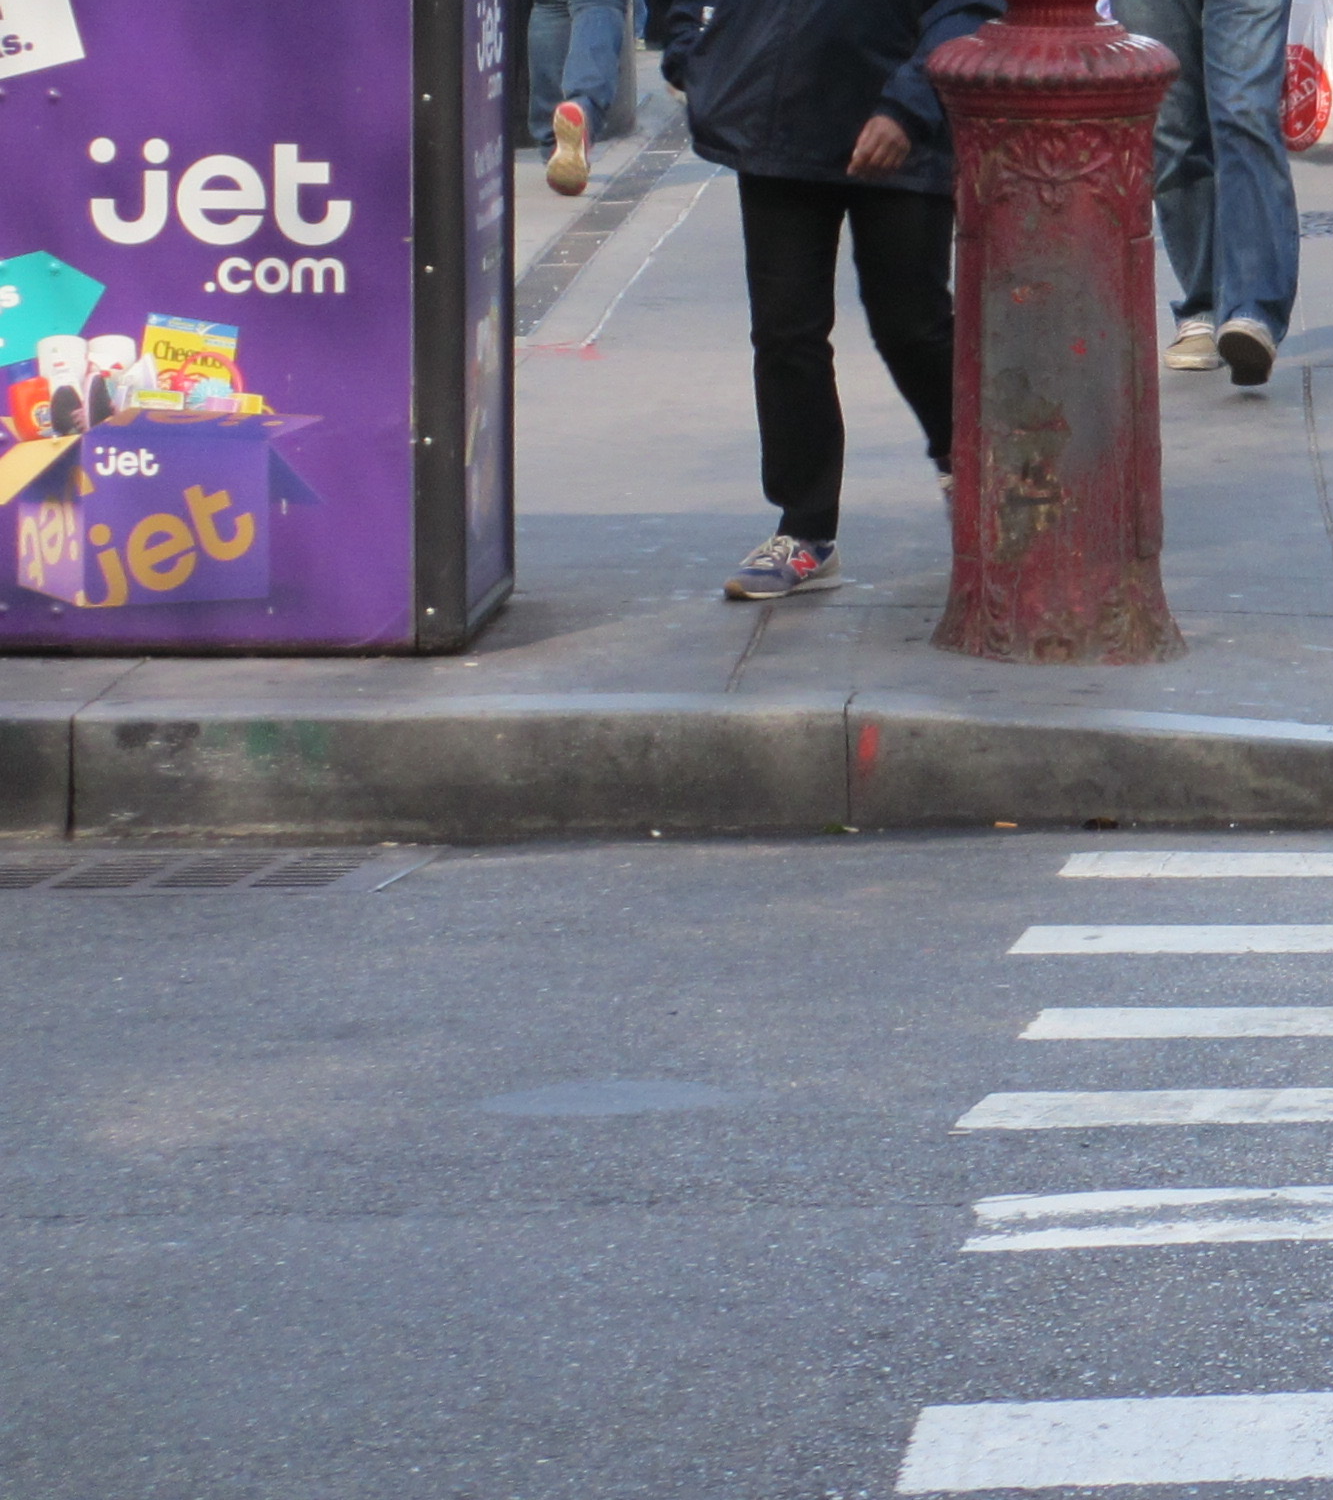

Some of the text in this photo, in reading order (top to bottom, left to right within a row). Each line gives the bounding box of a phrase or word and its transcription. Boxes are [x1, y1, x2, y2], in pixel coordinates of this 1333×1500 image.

[88, 136, 353, 246] jet
[203, 256, 346, 294] .com
[95, 446, 160, 477] jet
[76, 484, 256, 608] jet
